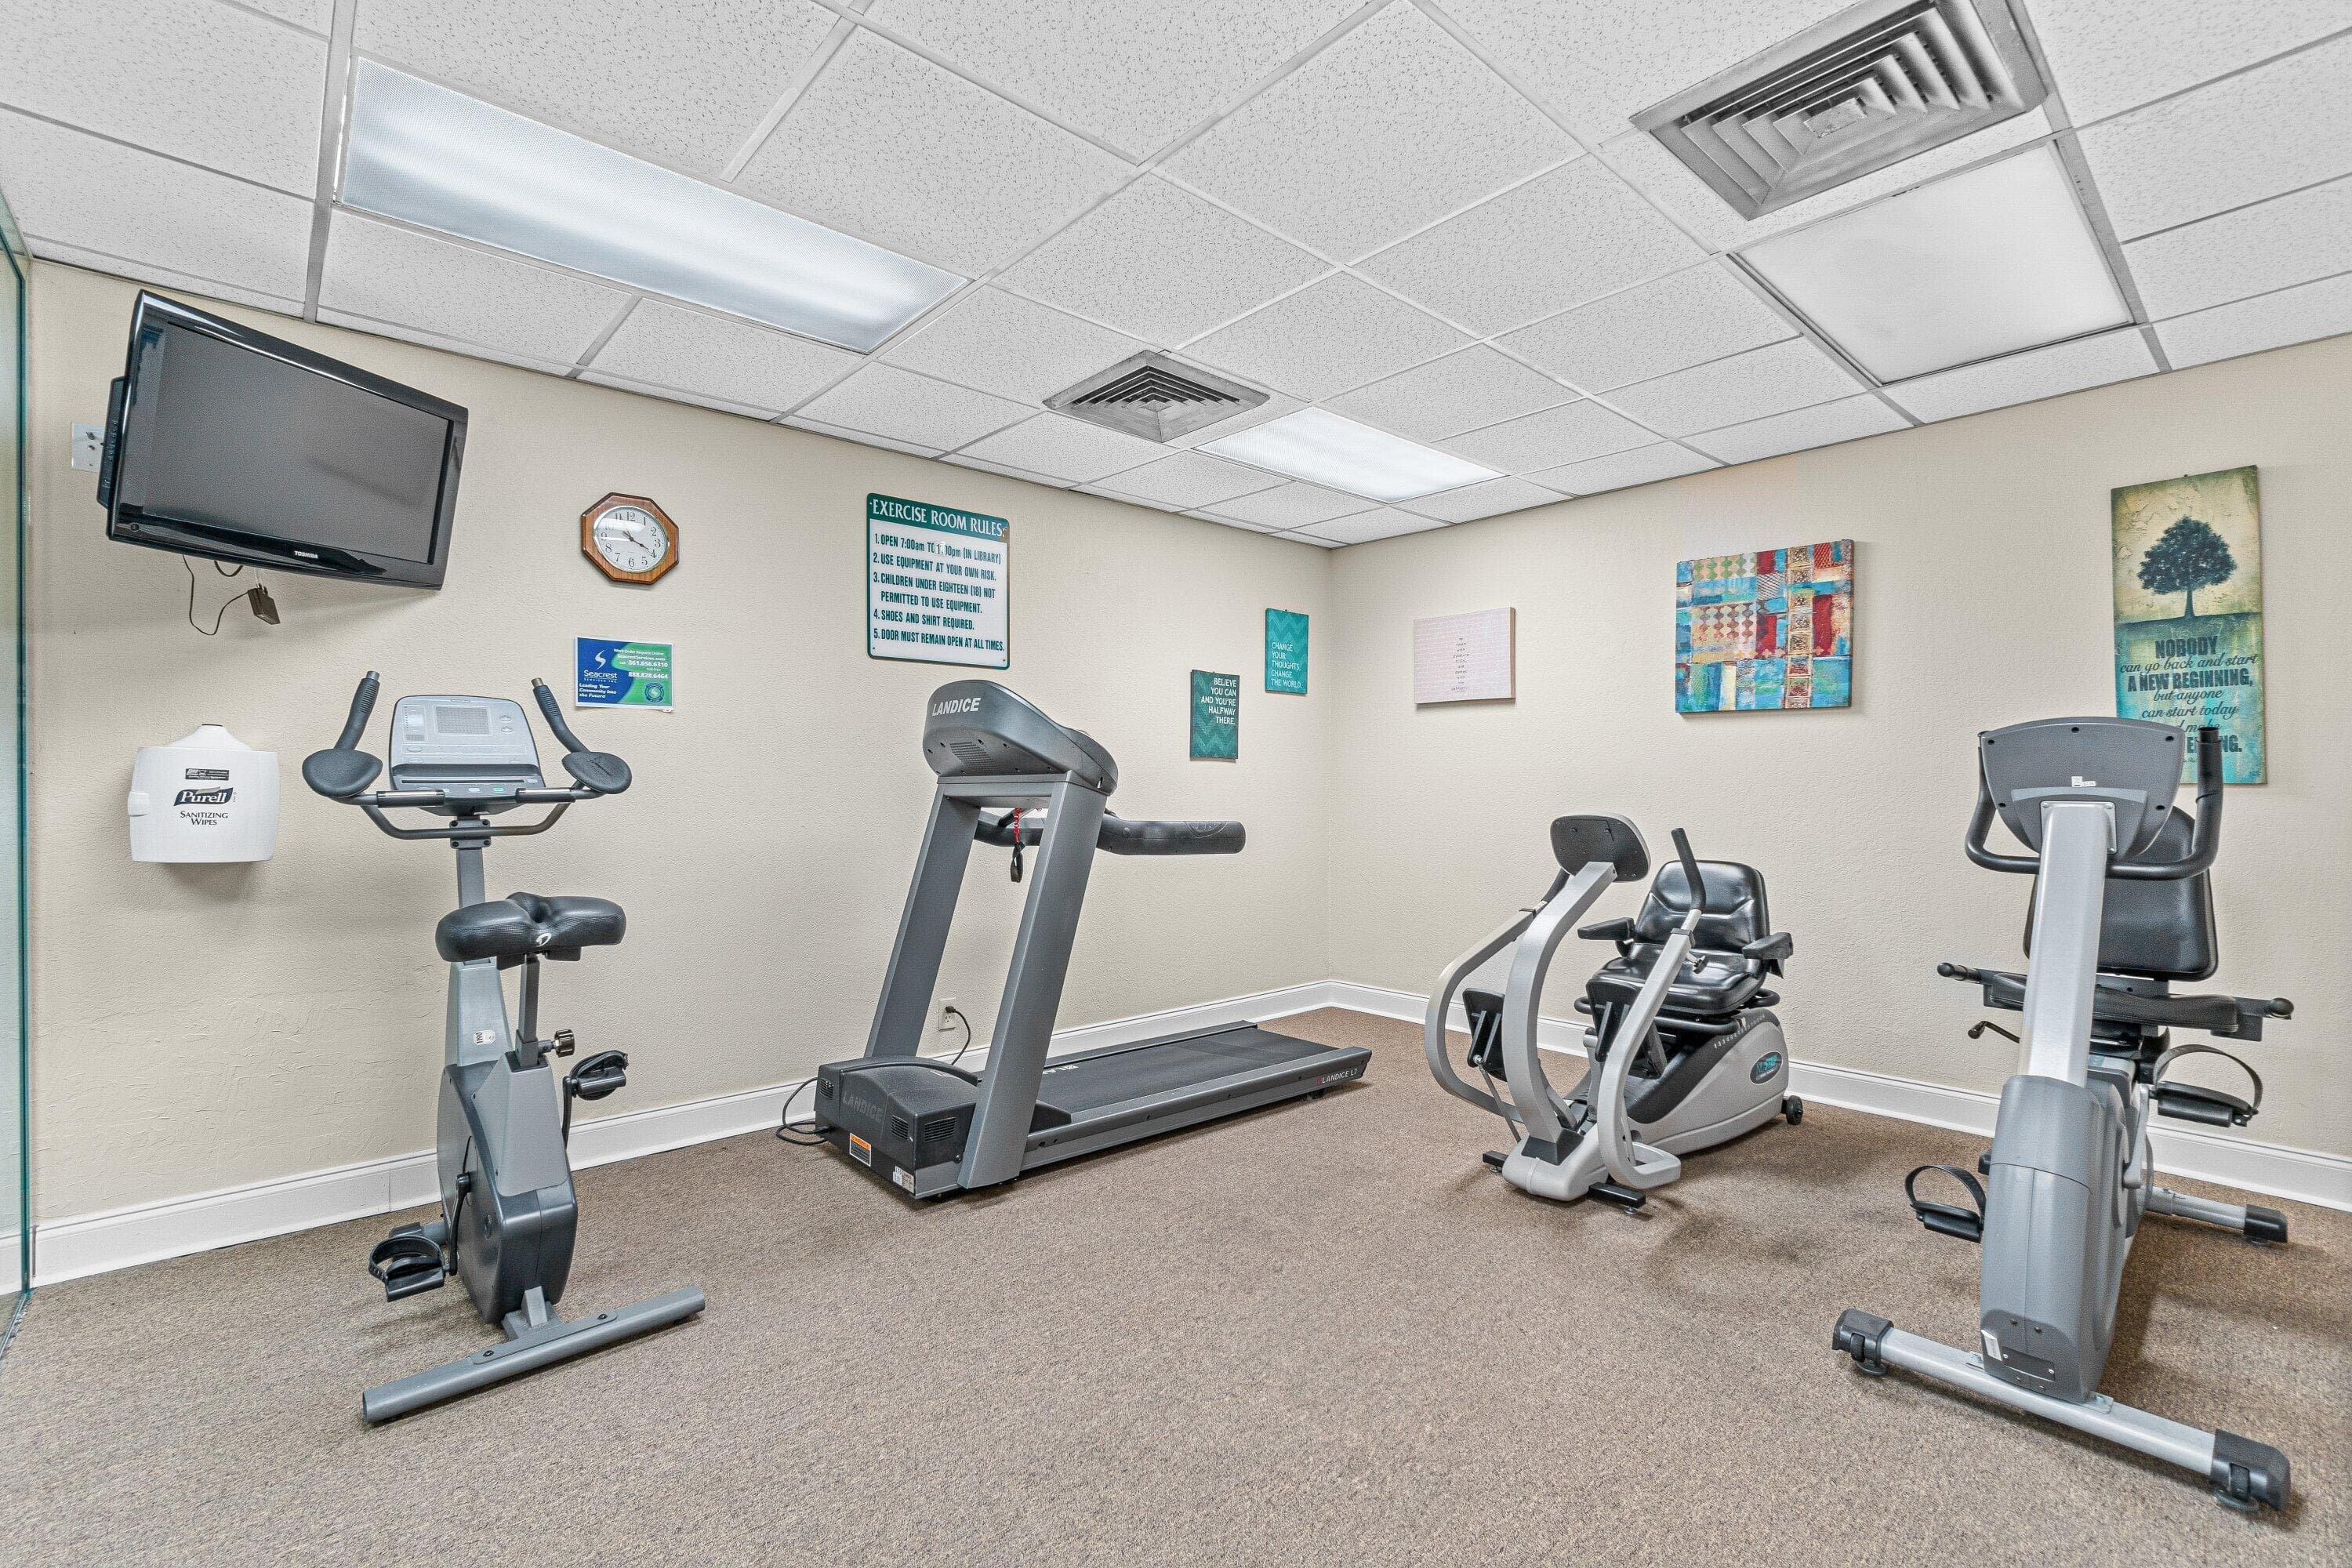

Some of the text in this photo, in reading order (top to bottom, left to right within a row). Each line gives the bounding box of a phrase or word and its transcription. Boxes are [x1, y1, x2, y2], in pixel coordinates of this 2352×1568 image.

[873, 499, 927, 523] EXERCISE
[931, 510, 966, 530] ROOM
[651, 527, 657, 536] 2
[605, 543, 612, 553] 8
[654, 539, 660, 548] 3
[875, 533, 880, 544] 1.
[881, 535, 898, 547] OPEN
[901, 538, 925, 551] 7:00am
[927, 543, 935, 553] TO
[964, 547, 972, 559] (IN
[975, 550, 1000, 564] LIBRARY)
[615, 552, 621, 562] 7
[629, 557, 635, 567] 6
[641, 557, 648, 565] 5
[873, 552, 996, 581] 2. USE EQUIPMENT AT YOUR OWN RISK.
[873, 572, 996, 598] 3. CHILDREN UNDER EIGHTEEN (18) NOT
[881, 591, 982, 613] PERMITTED TO USE EQUIPMENT.
[873, 608, 974, 630] 4. SHOES AND SHIRT REQUIRED.
[874, 629, 1004, 651] 5. DOOR MUST REMAIN OPEN AT ALL TIMES.
[1272, 642, 1293, 652] CHANGE
[2155, 636, 2218, 659] NOBODY
[1272, 651, 1286, 659] YOUR
[2140, 663, 2161, 676] go
[2164, 655, 2194, 670] back
[2198, 652, 2225, 667] and
[2226, 654, 2258, 666] start
[1272, 670, 1292, 678] CHANGE
[2128, 668, 2253, 691] A NEW BEGINNING,
[1214, 678, 1236, 687] BELIEVE
[1283, 680, 1303, 688] WORLD.
[1225, 688, 1236, 697] CAN
[2154, 688, 2223, 705] but anyone
[932, 698, 981, 716] LANDICE
[1215, 697, 1236, 706] YOU'RE
[1209, 706, 1236, 715] HALFWAY
[2166, 706, 2197, 717] start
[2200, 701, 2240, 720] today
[180, 791, 227, 803] Purell
[1322, 1071, 1348, 1083] LANDICE
[843, 1091, 883, 1123] LANDICE
